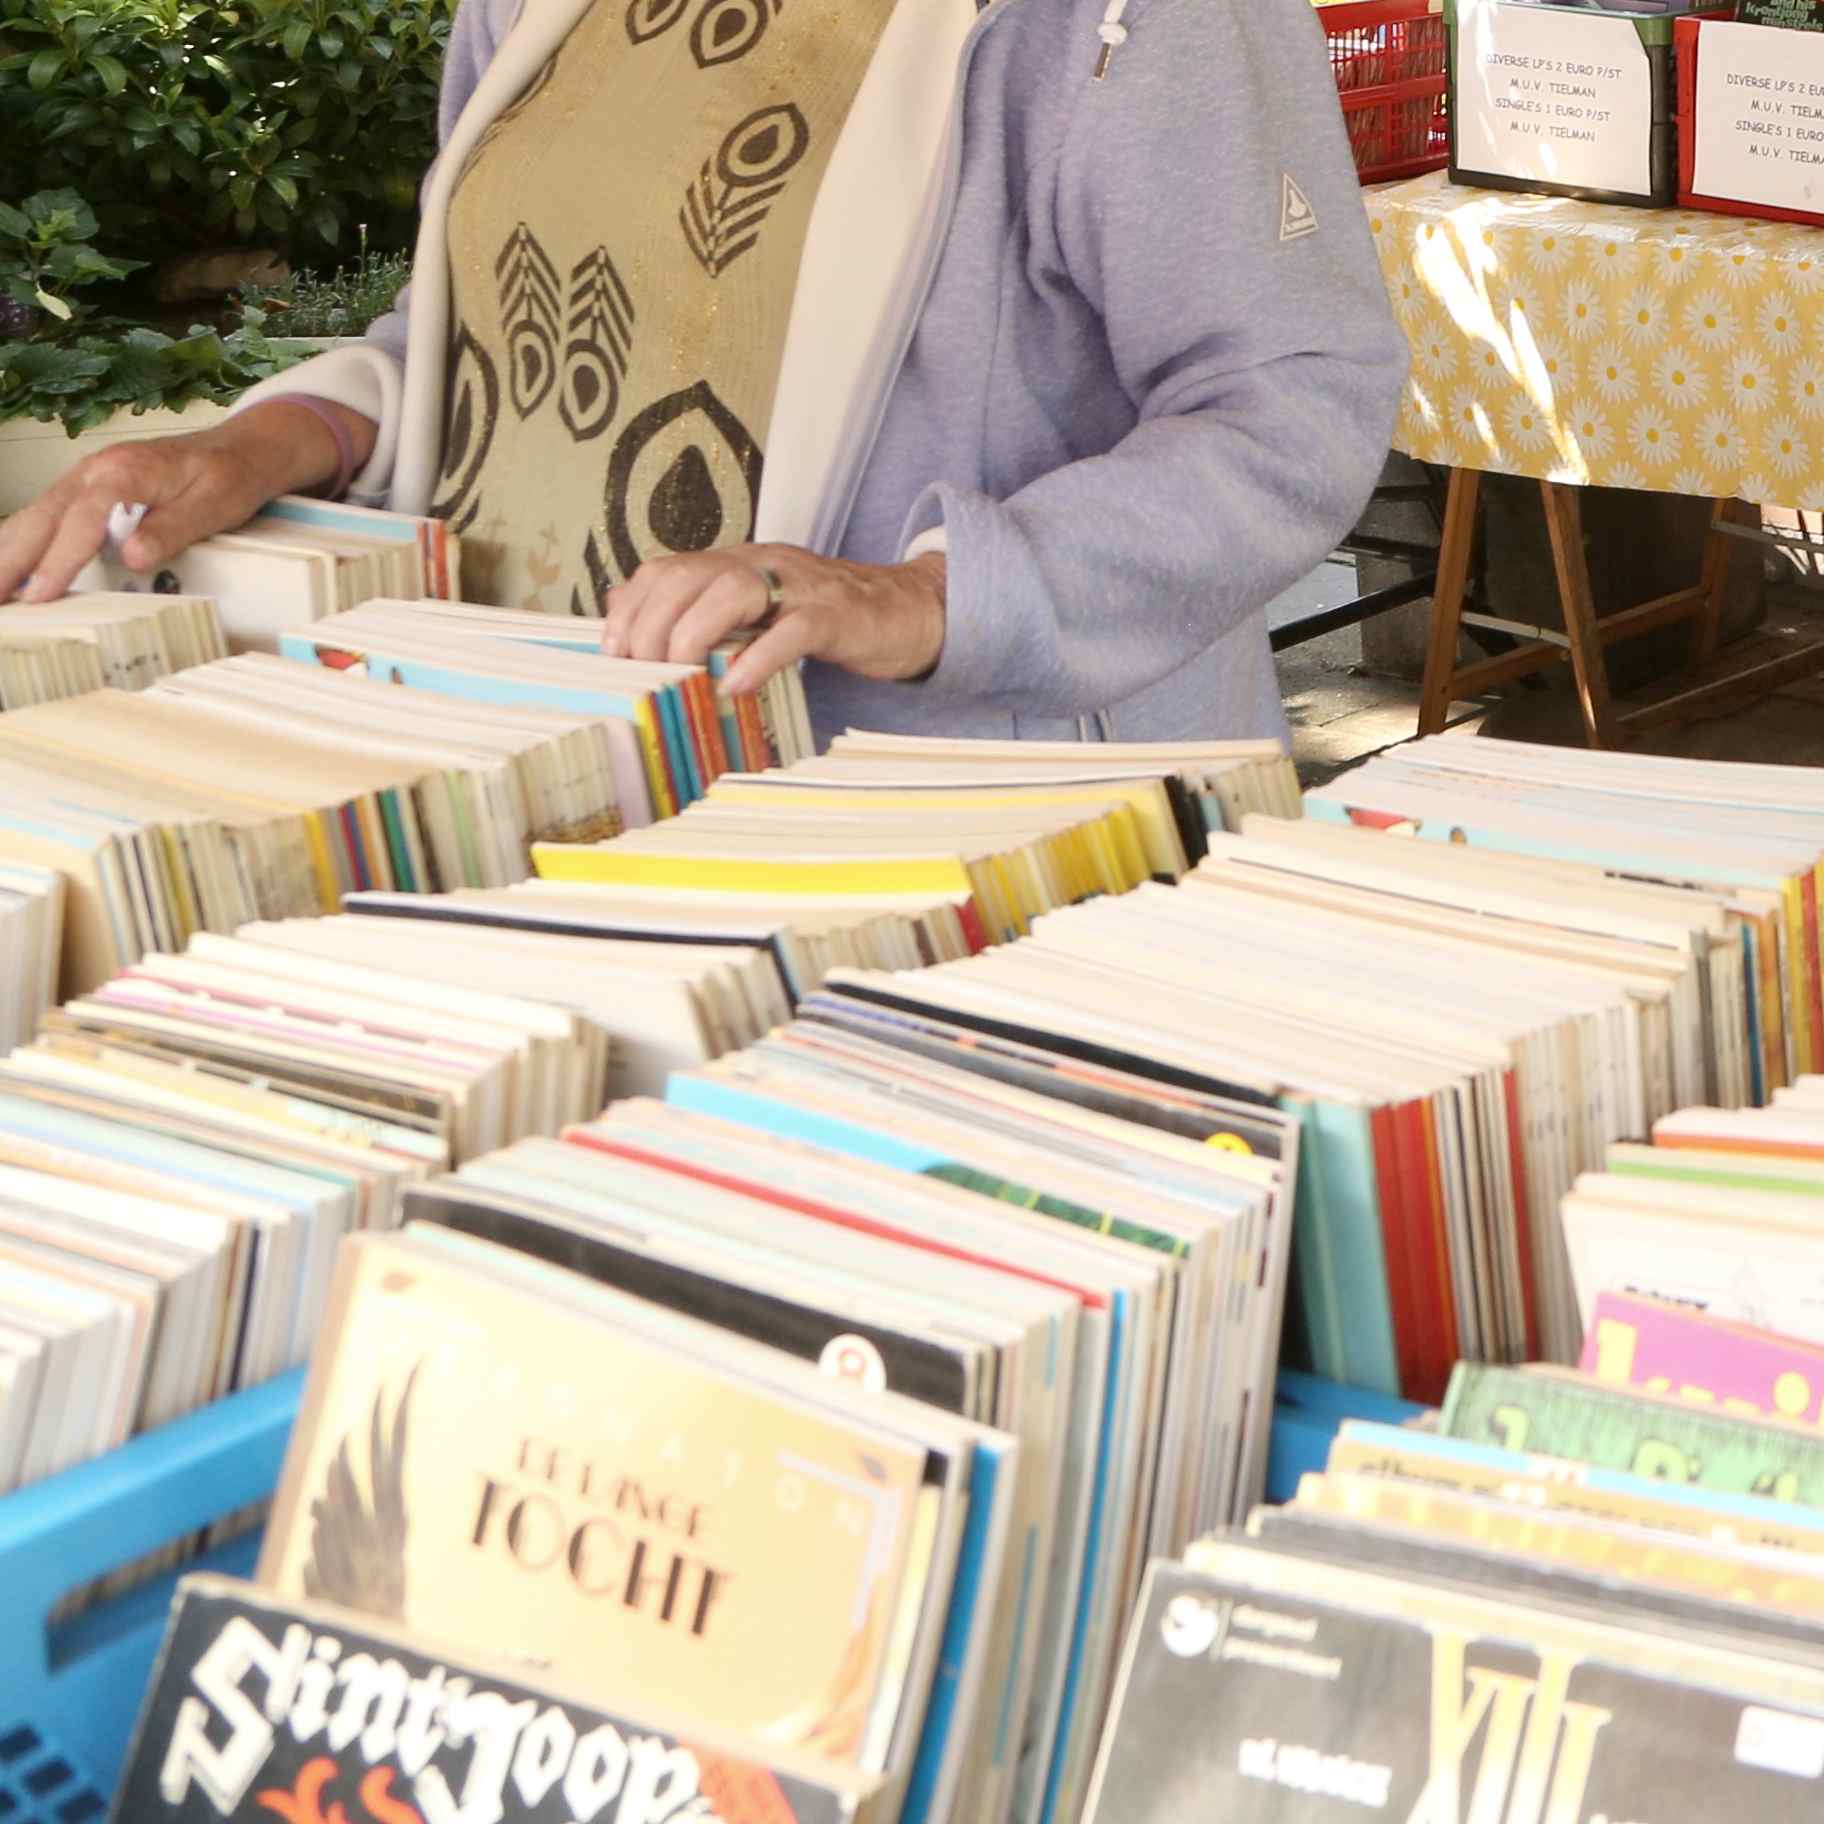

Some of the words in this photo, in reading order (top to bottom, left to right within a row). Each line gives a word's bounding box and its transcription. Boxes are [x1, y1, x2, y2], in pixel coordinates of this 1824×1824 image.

[1486, 54, 1529, 68] DIVERSE
[1567, 63, 1594, 76] EURO
[1597, 66, 1622, 79] P/ST
[1727, 74, 1771, 89] DIVERSE
[1550, 83, 1597, 98] TIELMAN
[1556, 105, 1583, 119] EURO
[1550, 126, 1595, 142] TIELMAN
[1796, 128, 1824, 142] EURO
[469, 1477, 738, 1638] TOCHT
